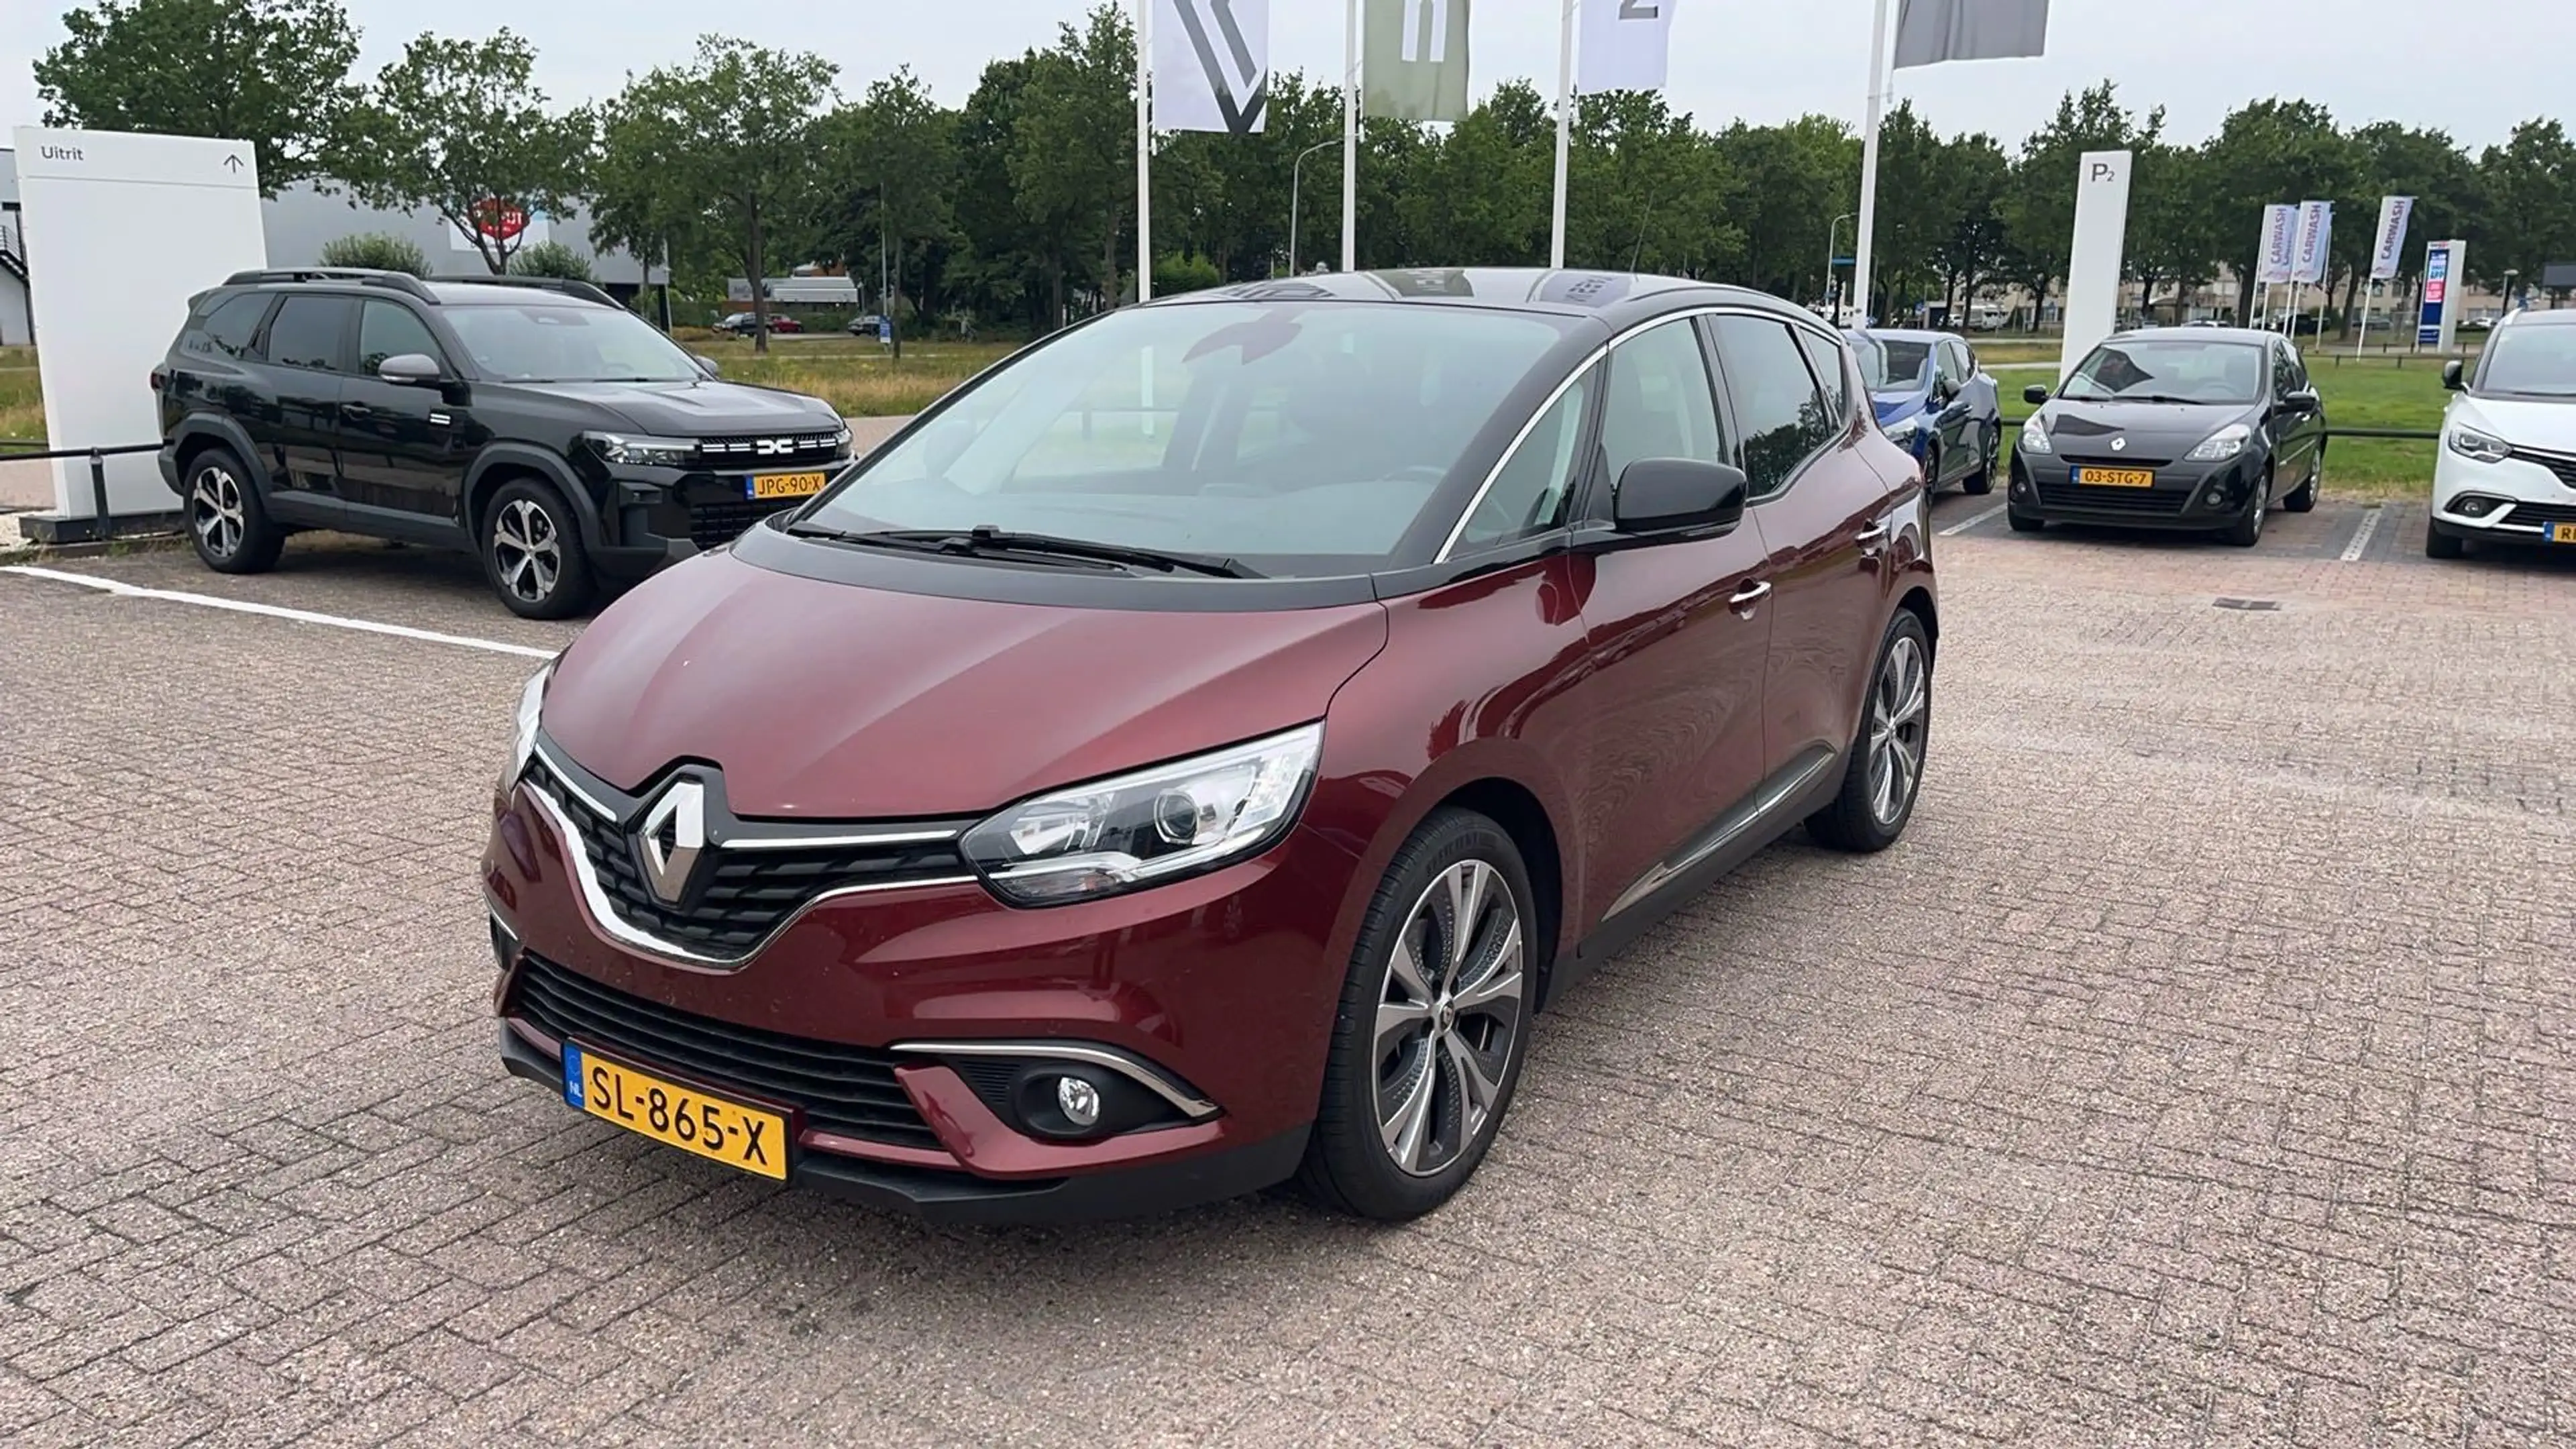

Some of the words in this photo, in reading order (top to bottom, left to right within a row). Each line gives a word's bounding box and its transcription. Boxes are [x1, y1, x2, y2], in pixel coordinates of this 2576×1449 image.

[41, 146, 84, 161] Uitrit
[2271, 207, 2287, 264] CARWASH
[2302, 204, 2322, 262] CARWASH
[2381, 201, 2406, 260] CARWASH
[758, 476, 820, 495] JPG-90-X
[2084, 471, 2147, 484] 03-STG-7
[570, 1081, 583, 1098] NL
[592, 1066, 768, 1166] SL-865-X
